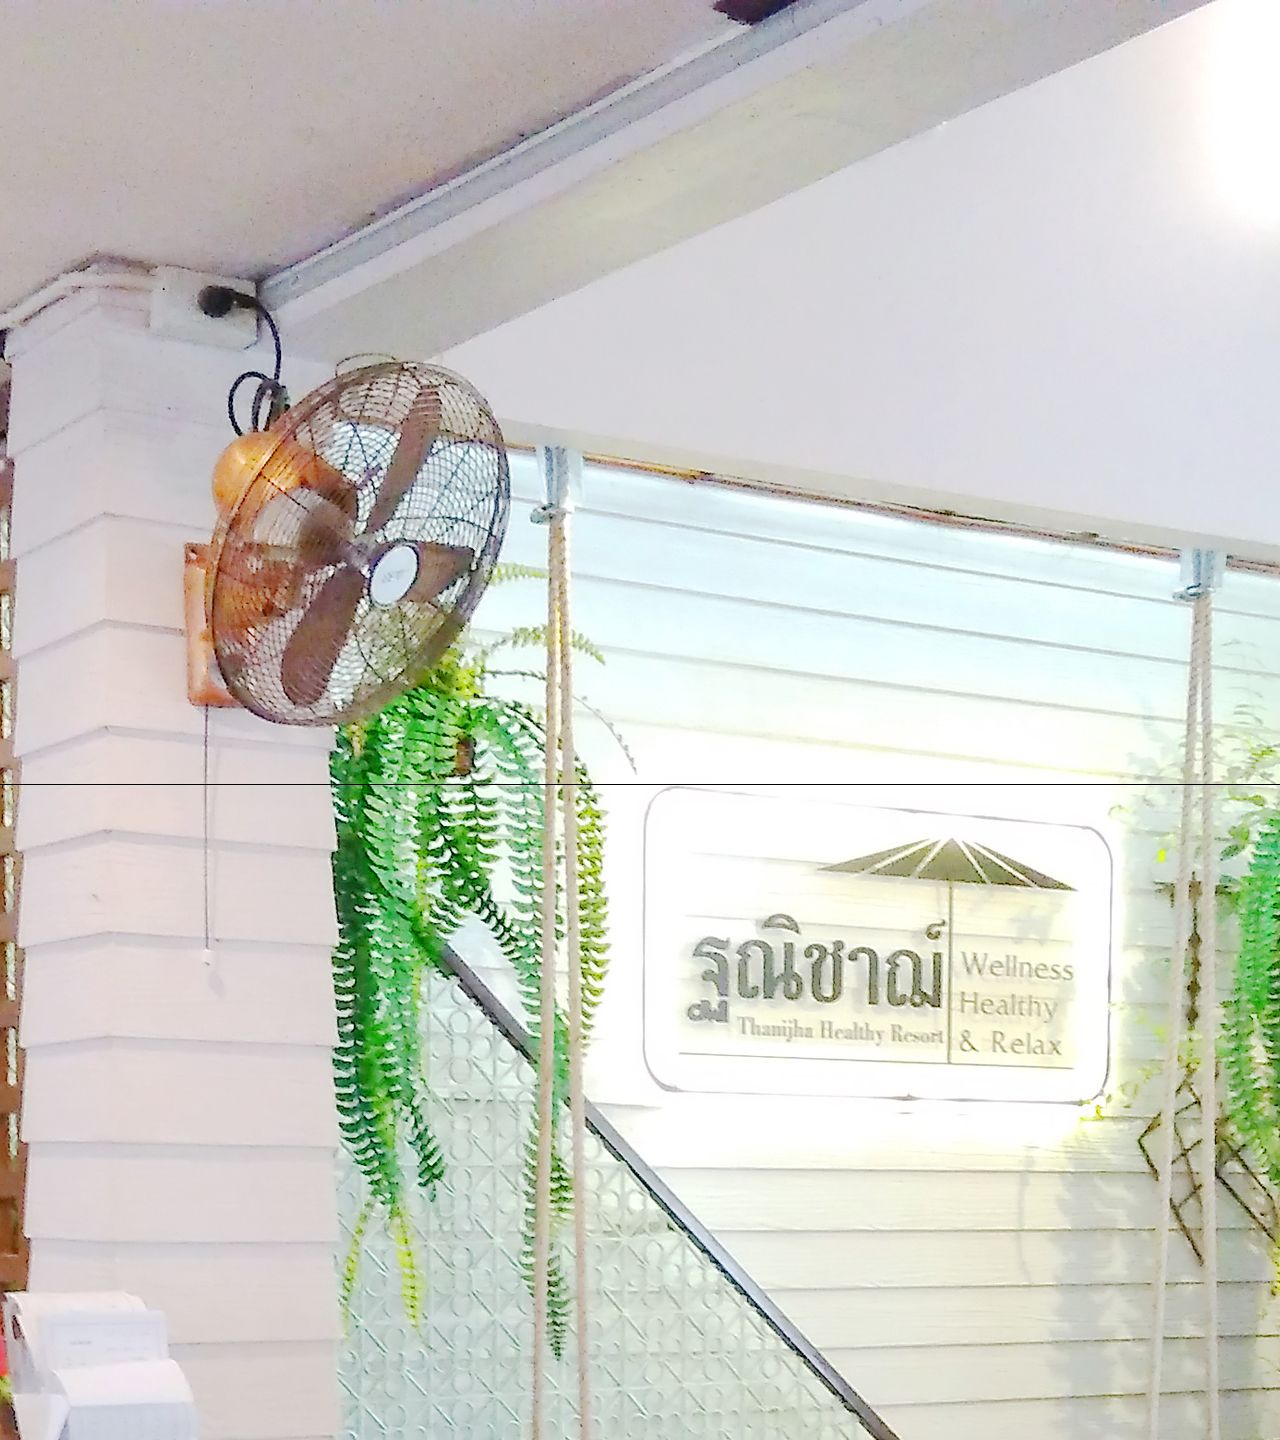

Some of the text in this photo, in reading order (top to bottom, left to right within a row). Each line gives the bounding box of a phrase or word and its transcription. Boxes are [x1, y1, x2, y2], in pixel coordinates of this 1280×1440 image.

[960, 951, 1074, 981] Wellness
[960, 991, 1058, 1023] Healthy
[819, 1020, 884, 1046] Healthy
[890, 1023, 944, 1045] Resort
[960, 1029, 1062, 1056] & Relax
